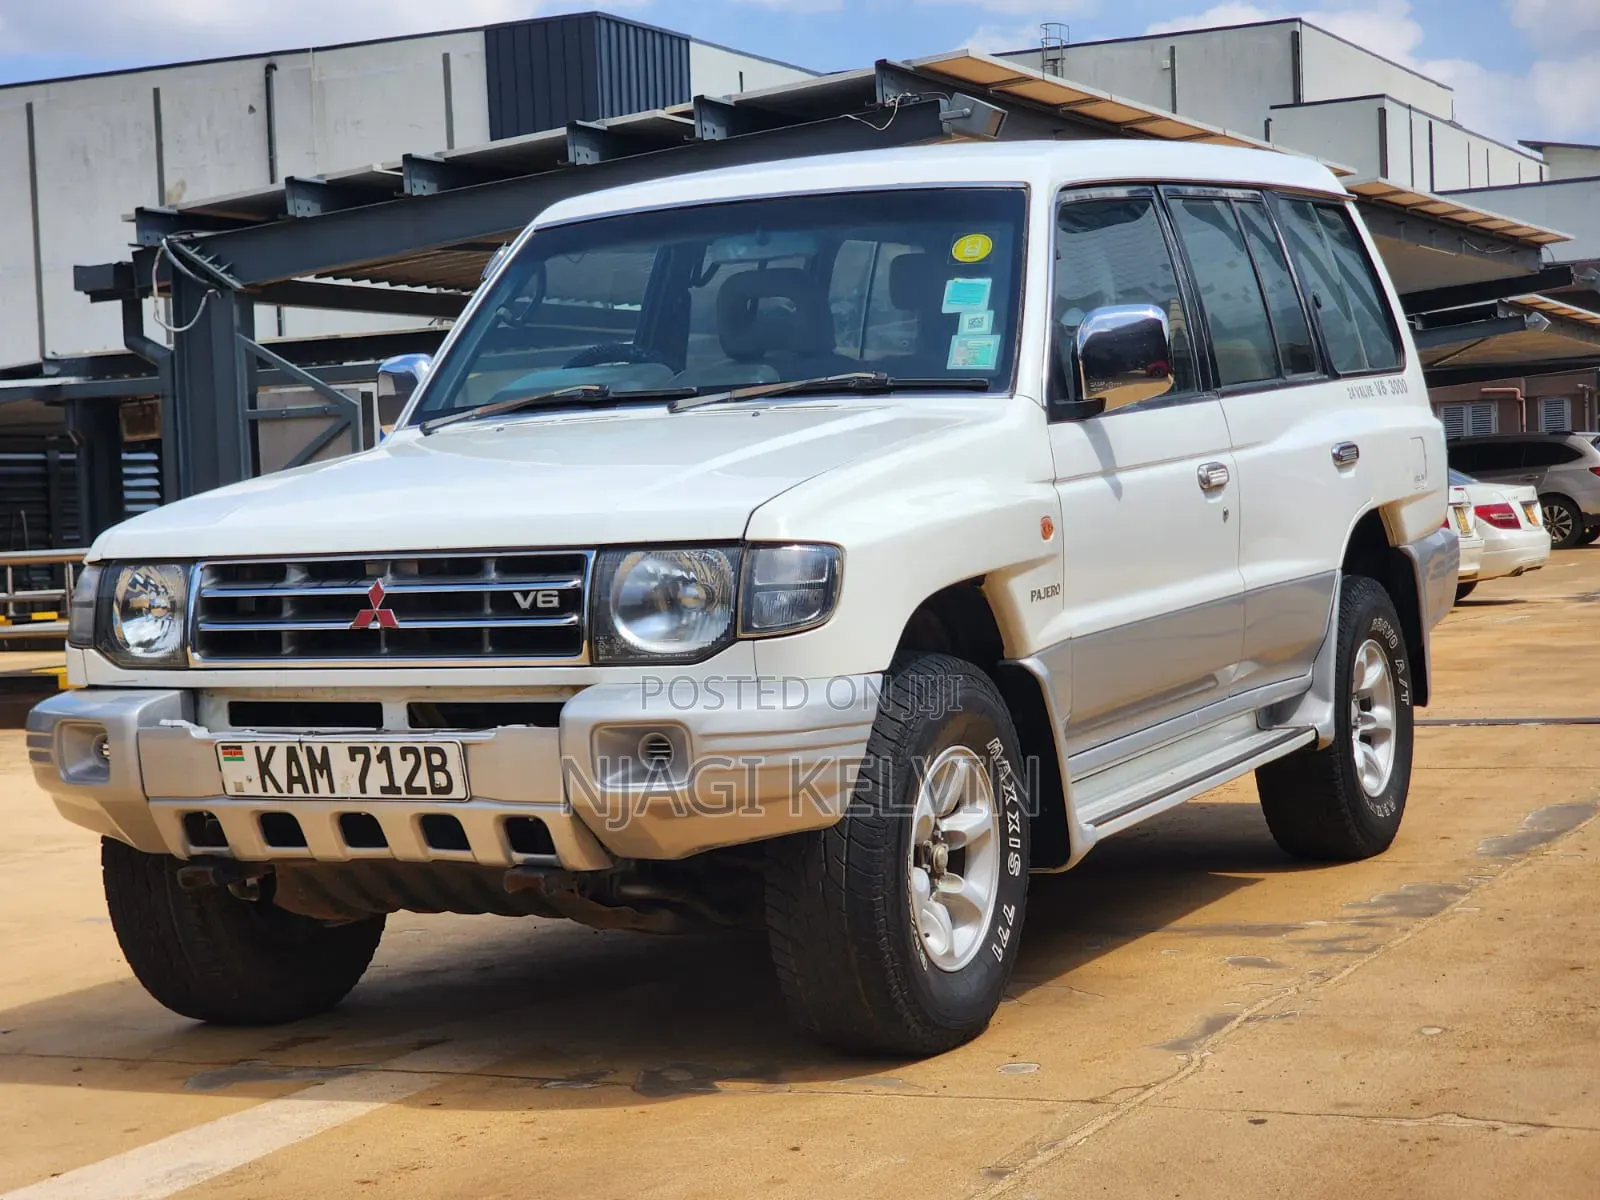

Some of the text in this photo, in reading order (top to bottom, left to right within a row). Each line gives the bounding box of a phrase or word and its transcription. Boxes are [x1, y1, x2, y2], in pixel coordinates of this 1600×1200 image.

[1388, 378, 1408, 395] 3000
[513, 590, 560, 609] V6
[1030, 583, 1060, 604] PAJERO
[254, 745, 454, 795] KAM 712B
[986, 737, 1021, 963] MAXXIS 771
